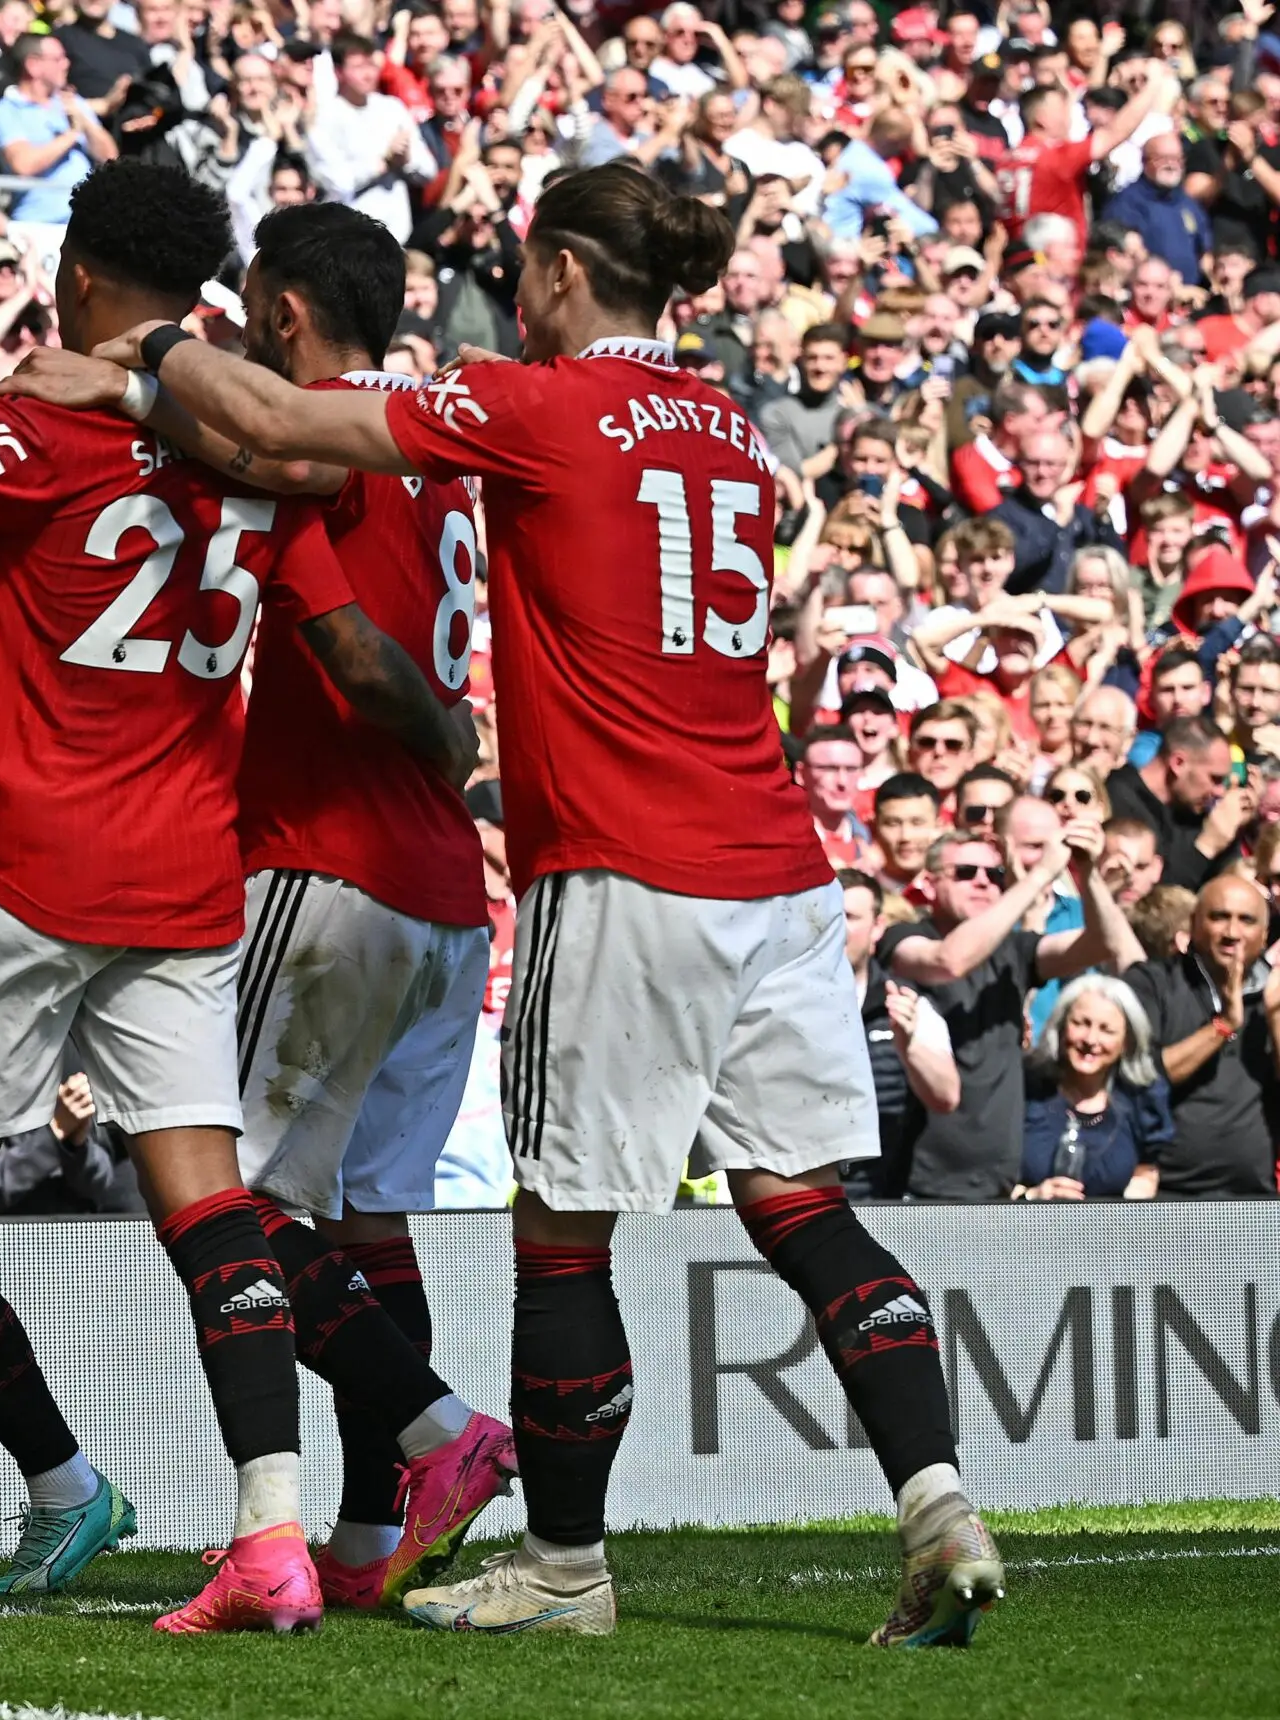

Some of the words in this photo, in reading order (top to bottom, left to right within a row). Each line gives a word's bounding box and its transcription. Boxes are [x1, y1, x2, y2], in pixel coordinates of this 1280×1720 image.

[59, 494, 276, 679] 25
[433, 510, 476, 690] 8
[636, 468, 769, 658] 15
[220, 1297, 290, 1313] adidas
